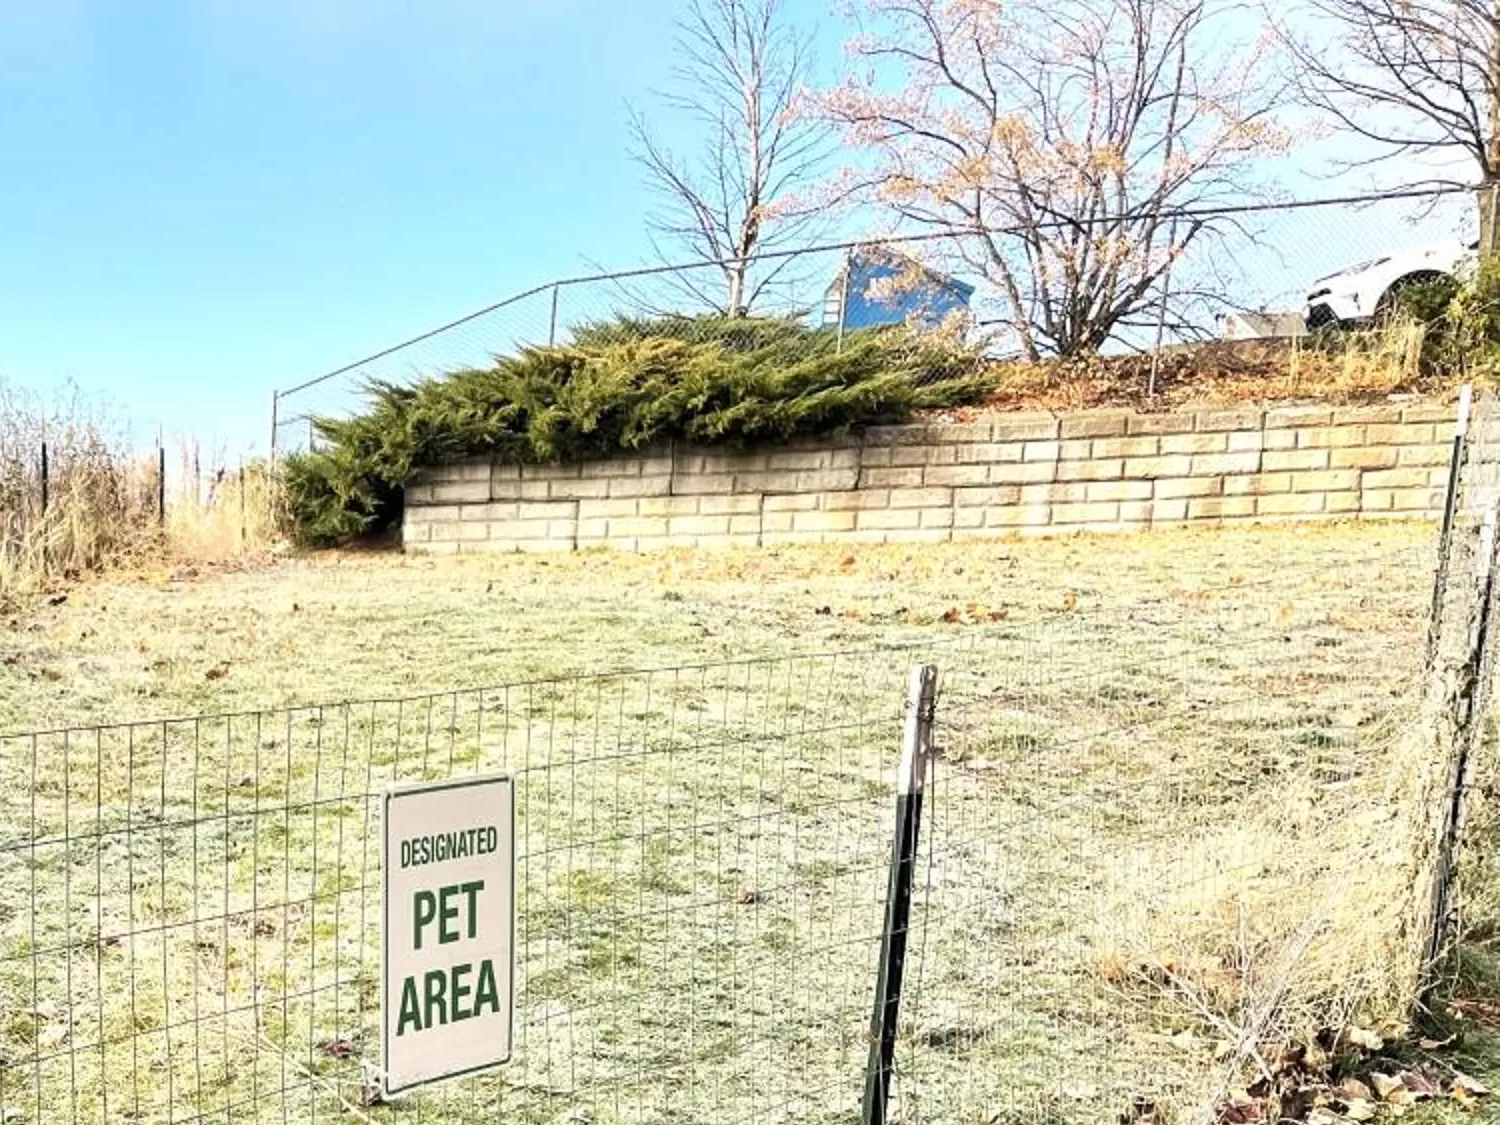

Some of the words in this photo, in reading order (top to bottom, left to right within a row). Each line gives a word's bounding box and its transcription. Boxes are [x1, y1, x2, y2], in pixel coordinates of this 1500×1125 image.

[400, 825, 498, 869] DESIGNATED
[413, 879, 485, 950] PET
[396, 959, 501, 1037] AREA
